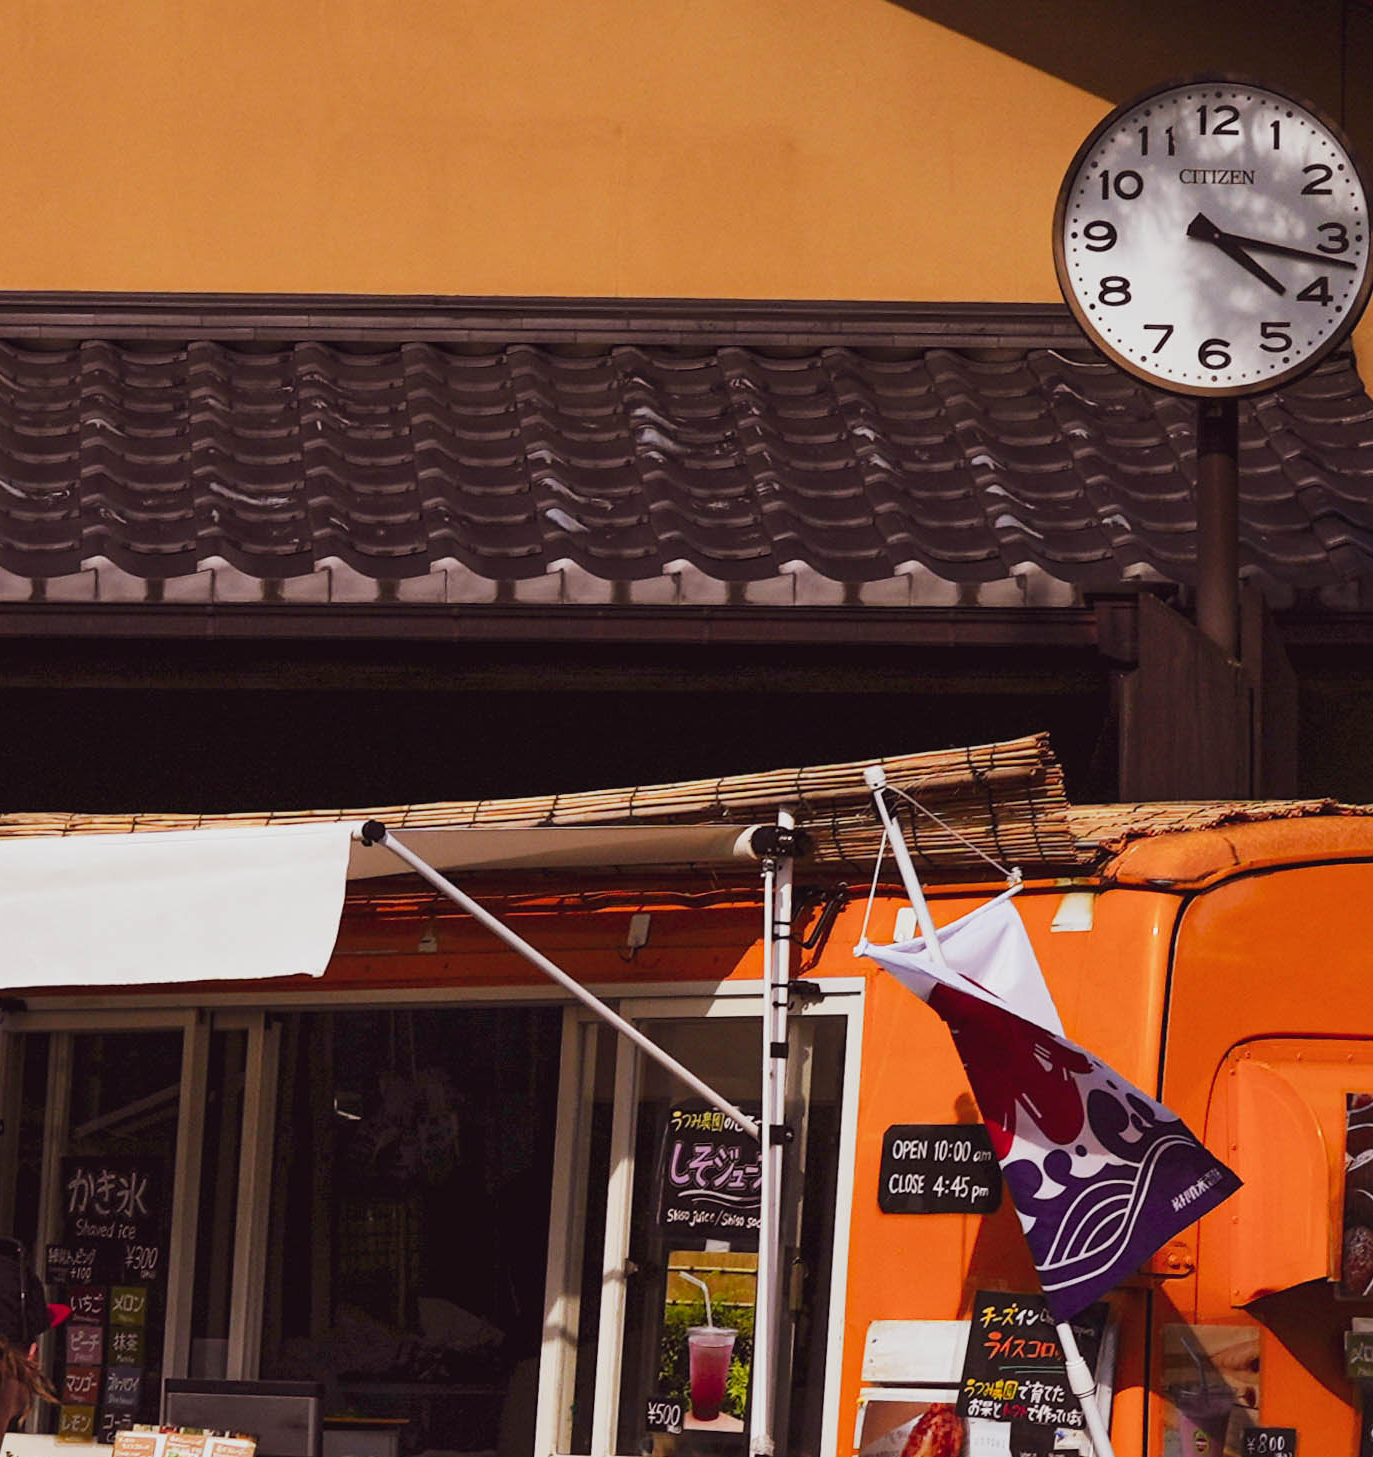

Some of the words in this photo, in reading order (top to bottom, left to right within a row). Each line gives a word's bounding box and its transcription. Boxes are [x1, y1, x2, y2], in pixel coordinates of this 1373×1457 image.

[1196, 104, 1241, 136] 12
[1269, 120, 1281, 150] 1
[1137, 126, 1177, 156] 11
[1099, 170, 1145, 200] 10
[1179, 169, 1256, 185] CITIZEN
[1300, 164, 1334, 195] 2
[1083, 220, 1118, 252] 9
[1316, 222, 1350, 254] 3
[1098, 276, 1133, 306] 8
[1296, 276, 1334, 307] 4
[1143, 324, 1175, 353] 7
[1260, 321, 1293, 353] 5
[1198, 338, 1232, 370] 6
[892, 1140, 928, 1160] OPEN
[934, 1140, 972, 1162] 10:00
[68, 1168, 148, 1218] かき氷
[889, 1174, 926, 1194] CLOSE
[932, 1176, 971, 1198] 4:45
[972, 1185, 989, 1204] pm
[75, 1218, 116, 1238] Shaved
[117, 1223, 137, 1240] ice
[124, 1244, 159, 1270] ¥300
[70, 1293, 105, 1314] いちご
[112, 1294, 145, 1313] メロン
[70, 1330, 100, 1352] ピーチ
[982, 1331, 1064, 1361] ライスコロ
[66, 1372, 97, 1393] マンゴー
[61, 1415, 91, 1433] レモン
[647, 1401, 681, 1426] ¥500
[1246, 1433, 1285, 1454] ¥800
